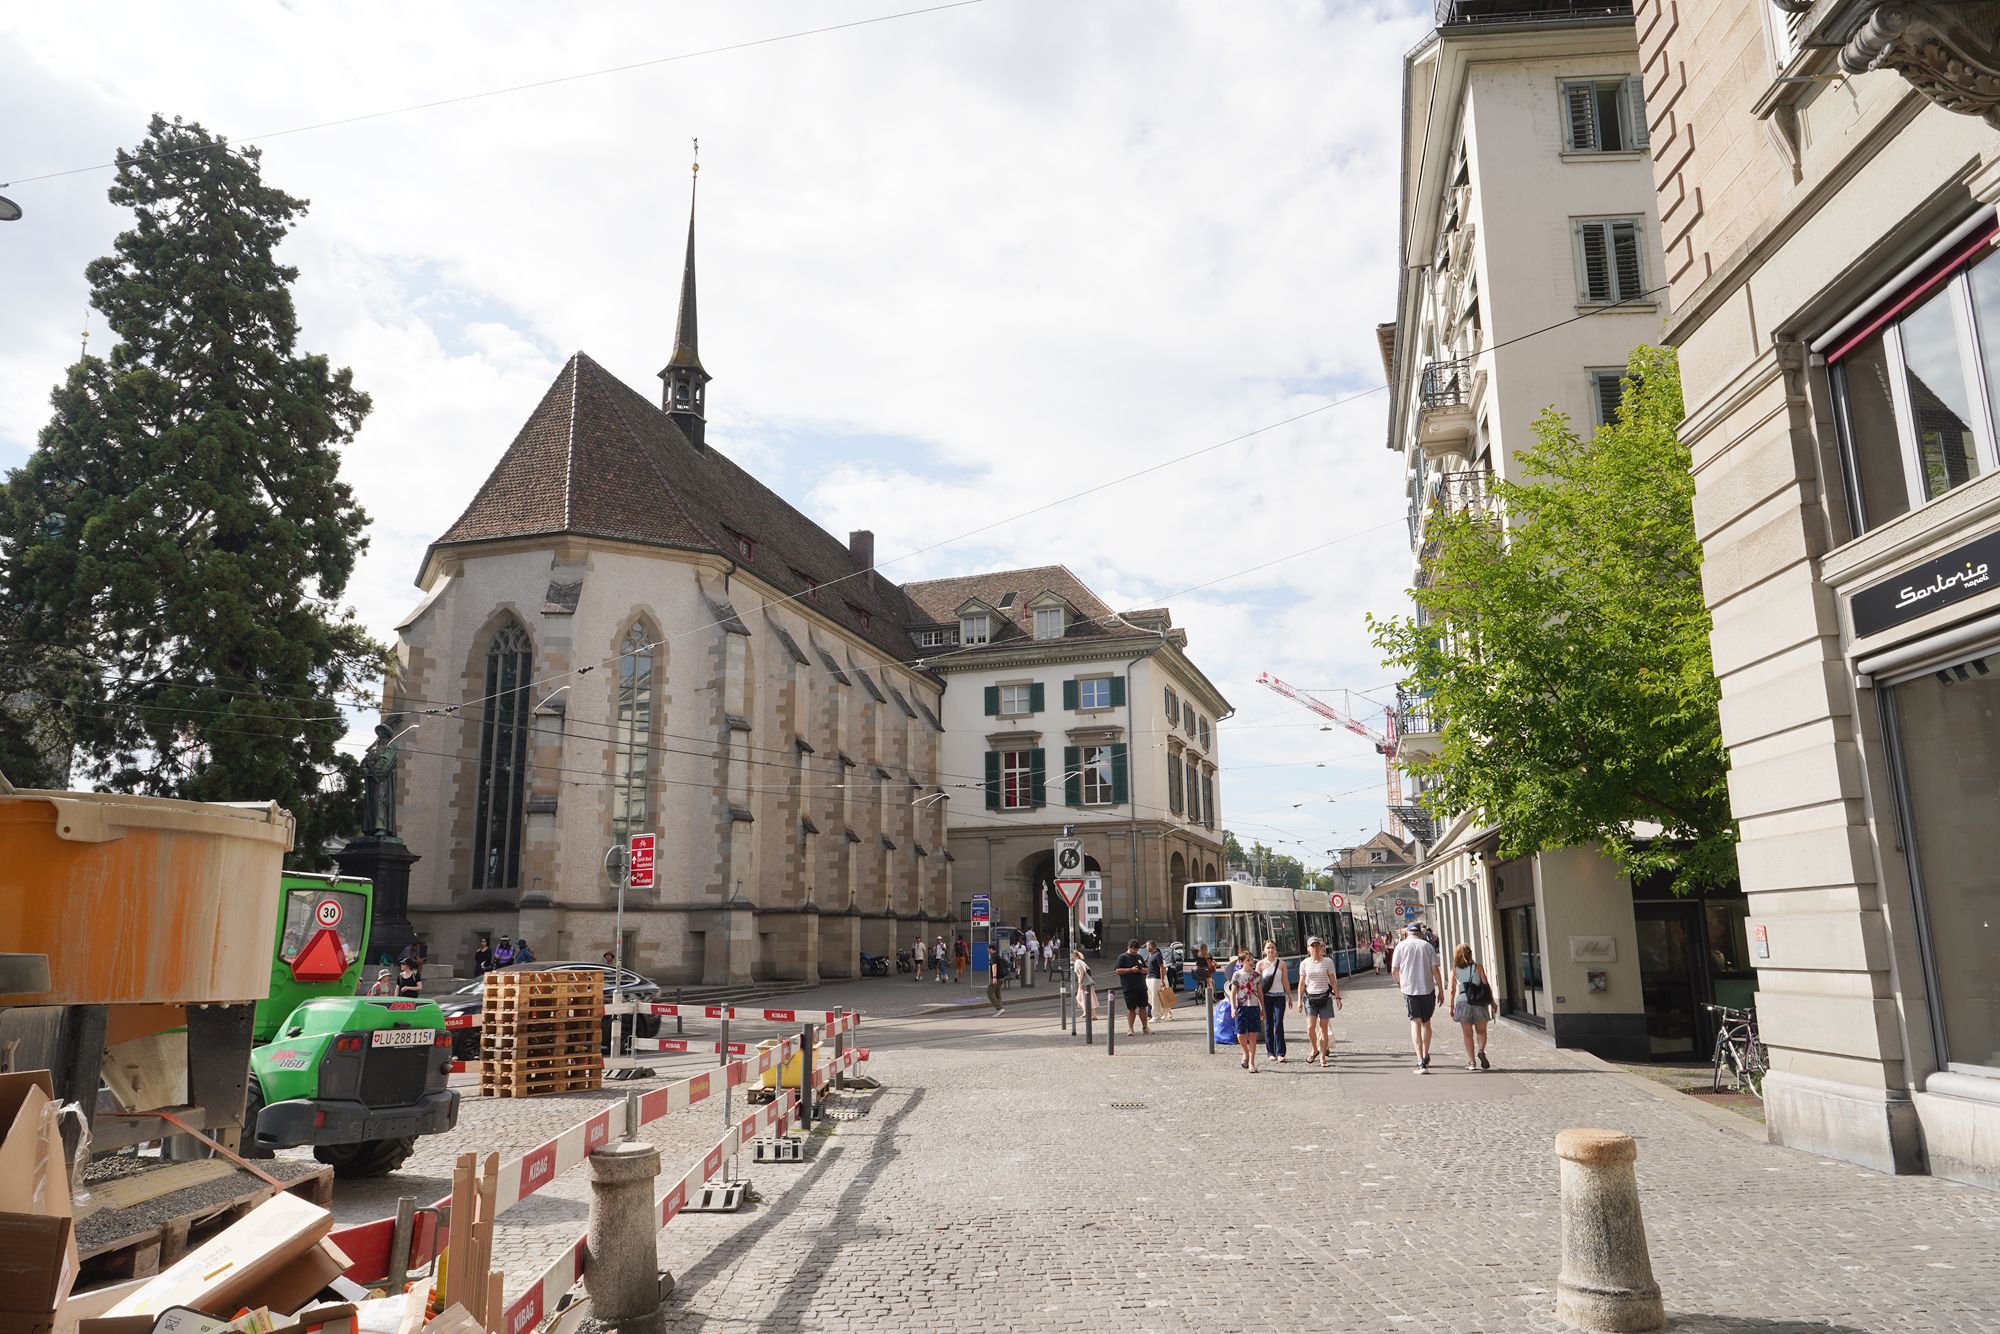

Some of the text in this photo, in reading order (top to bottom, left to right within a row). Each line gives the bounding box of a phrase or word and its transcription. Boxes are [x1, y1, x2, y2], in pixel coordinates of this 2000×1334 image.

[1895, 562, 1988, 609] Sartorio
[1963, 573, 1988, 588] napoli
[1204, 887, 1211, 896] 4
[323, 907, 336, 919] 30
[656, 1006, 672, 1014] KIBAG
[771, 1011, 788, 1019] KIBAG
[445, 1018, 464, 1028] KIBAG
[528, 1156, 548, 1182] KIBAG
[513, 1299, 535, 1334] KIBAG
